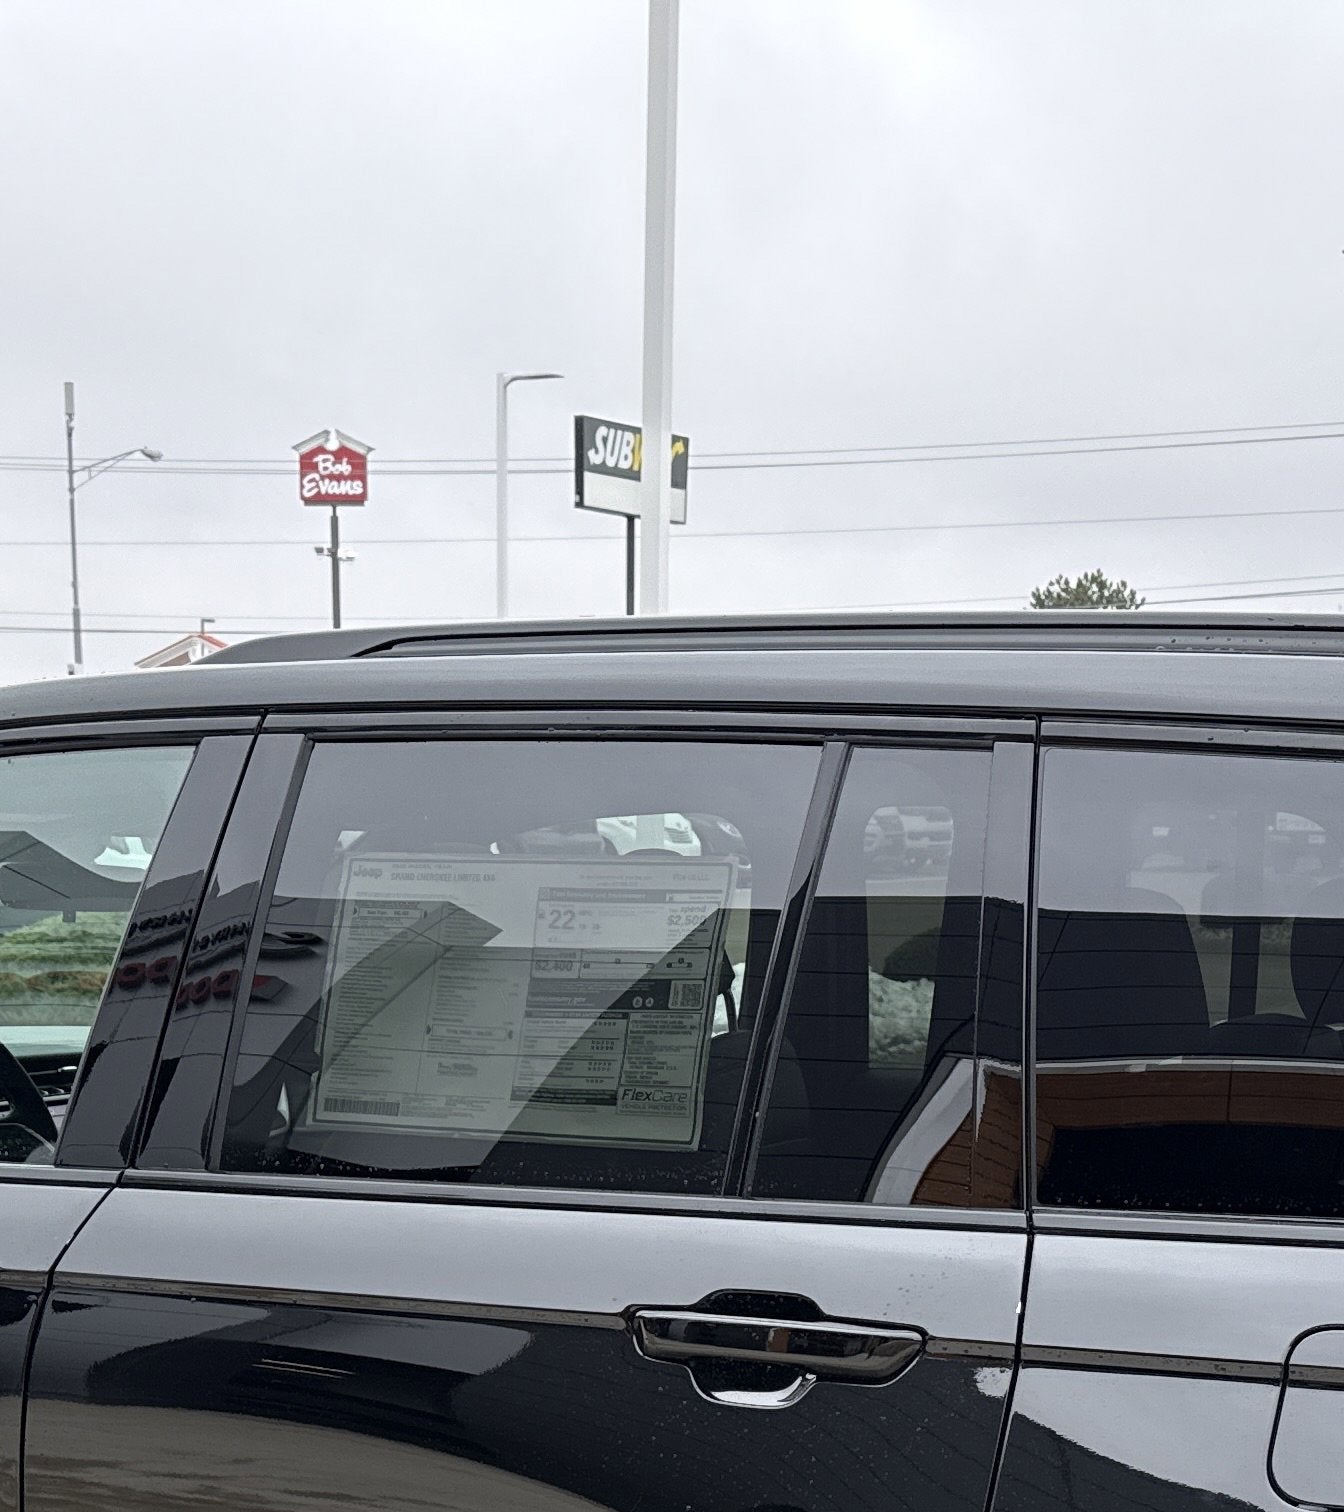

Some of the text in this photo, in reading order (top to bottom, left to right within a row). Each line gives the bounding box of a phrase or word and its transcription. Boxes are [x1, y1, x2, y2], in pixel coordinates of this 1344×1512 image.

[313, 454, 352, 476] Bob
[302, 474, 364, 498] Evans
[621, 1087, 688, 1103] FlexCare
